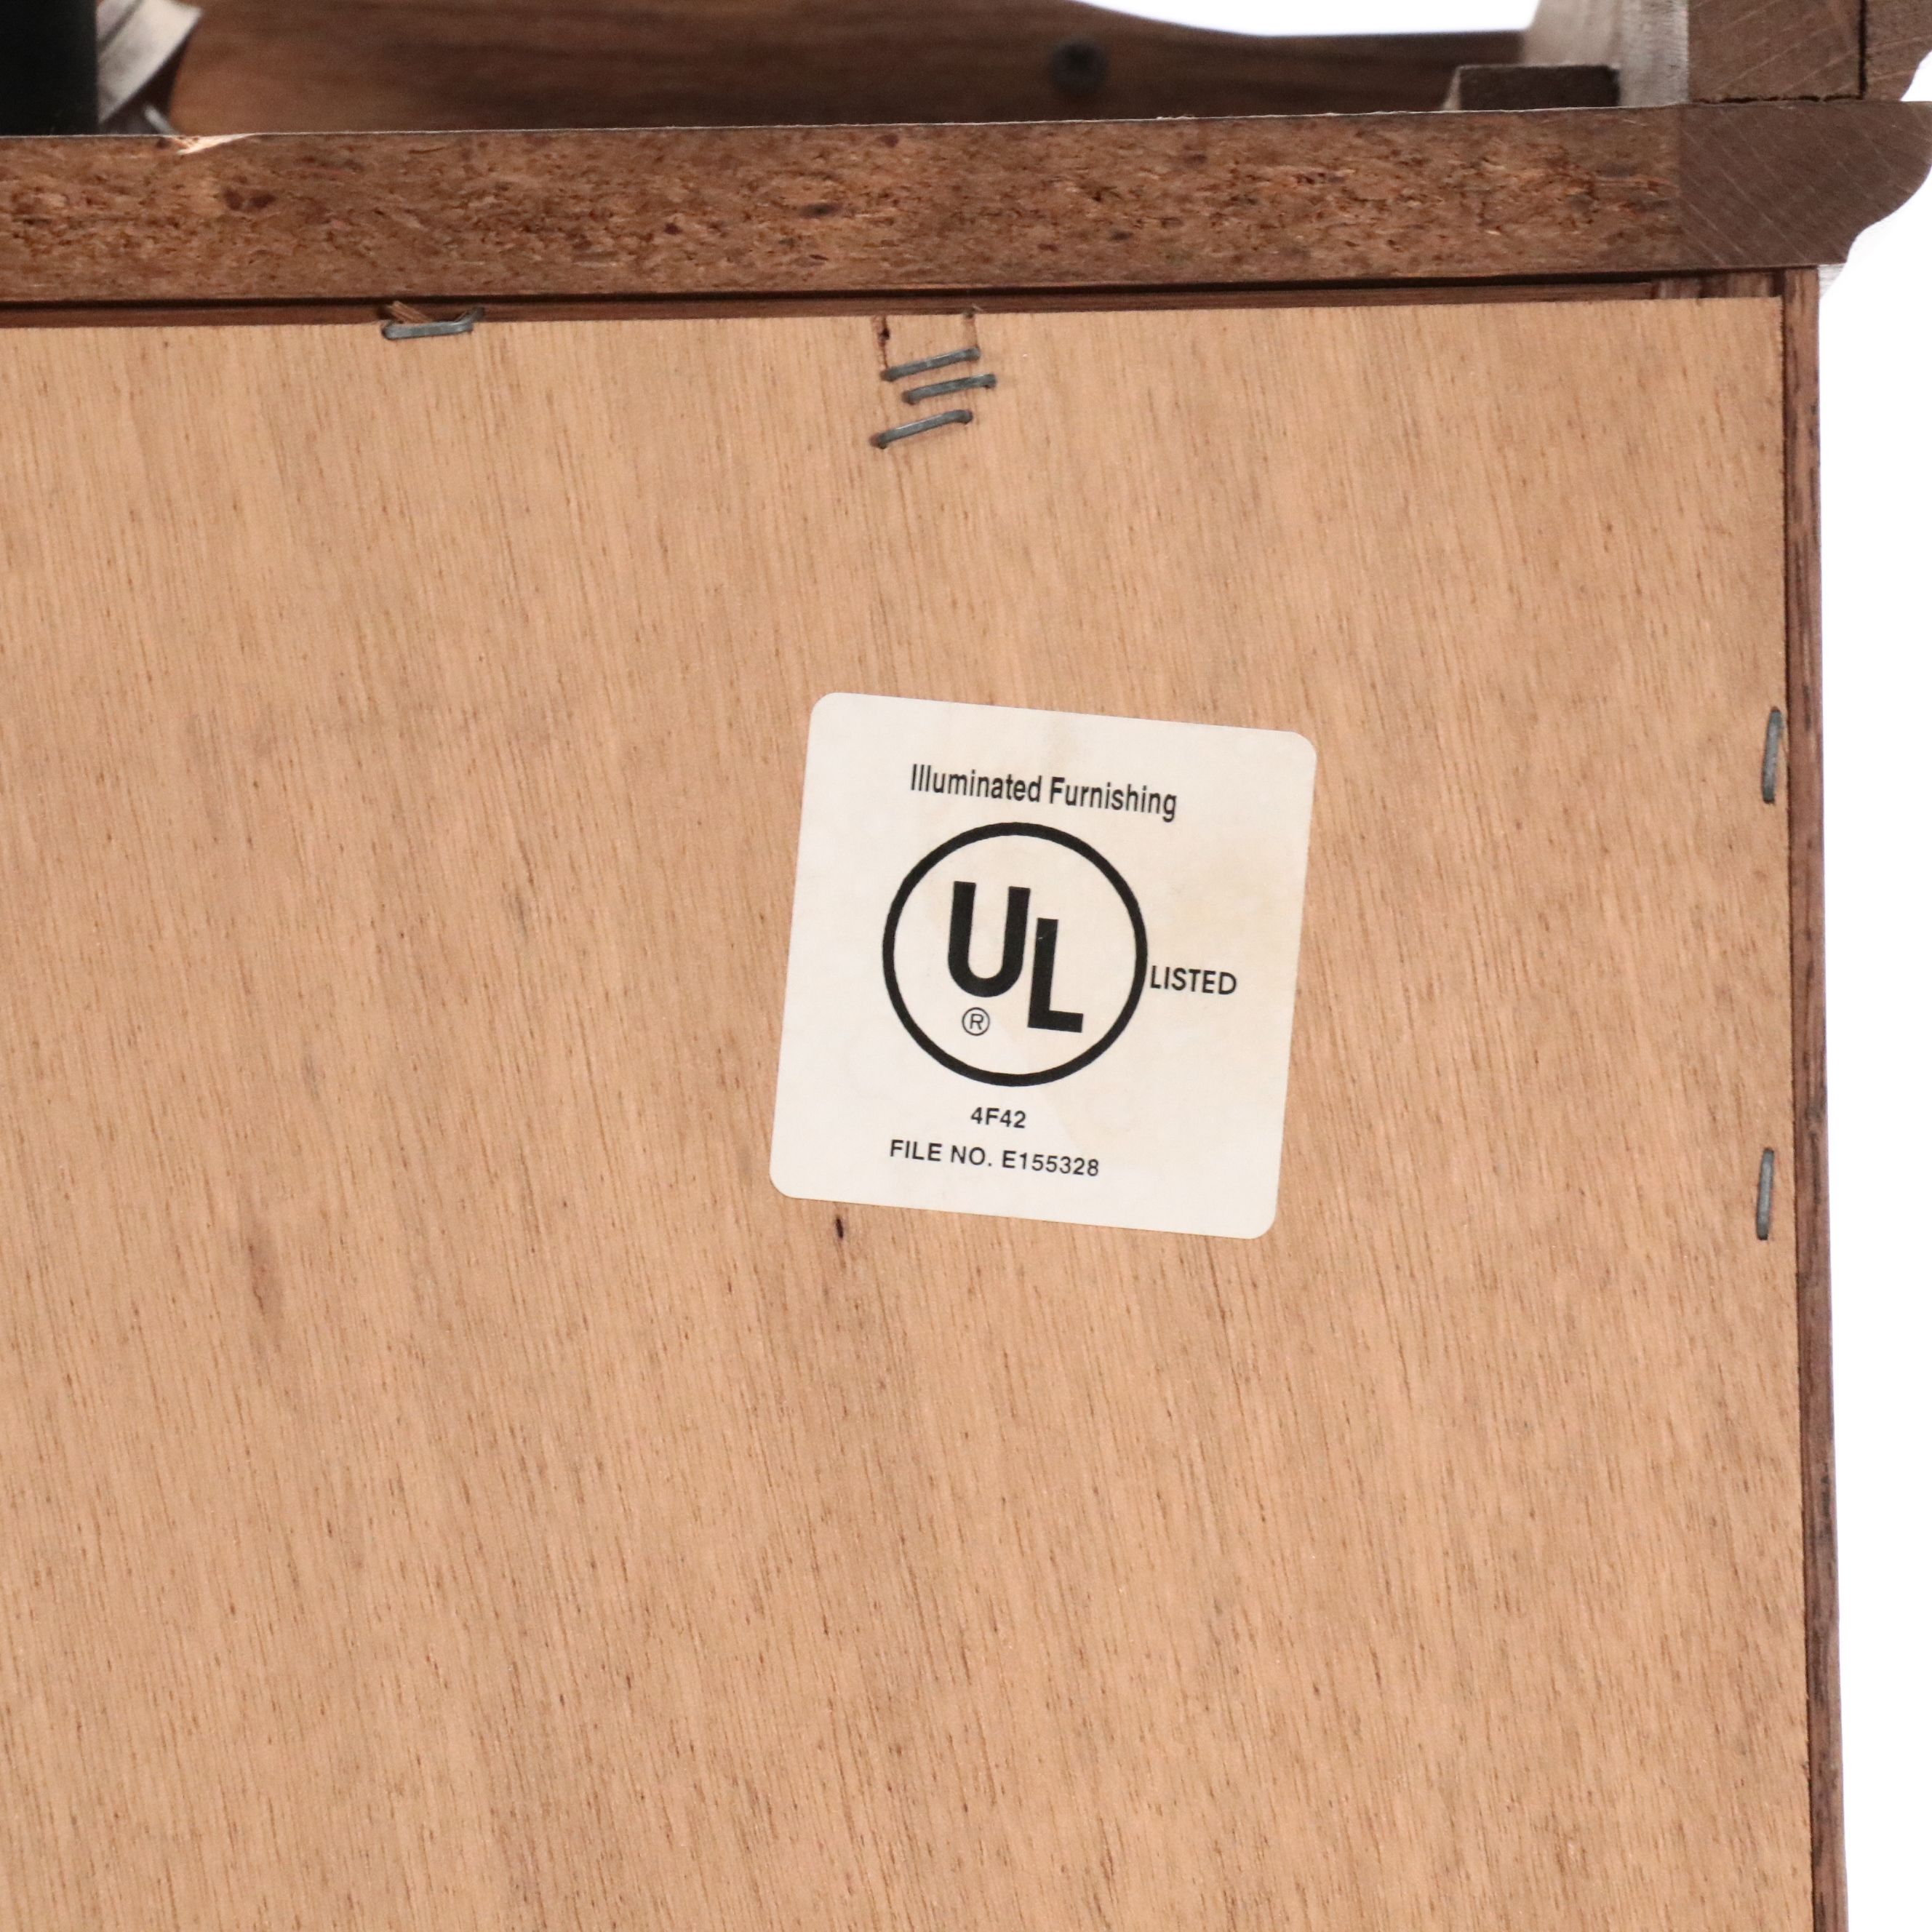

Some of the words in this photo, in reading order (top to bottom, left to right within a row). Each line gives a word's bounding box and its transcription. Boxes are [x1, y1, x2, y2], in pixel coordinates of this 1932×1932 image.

[911, 764, 1042, 803] Illuminated
[1050, 776, 1177, 823] Furnishing
[947, 880, 1084, 1034] UL
[1150, 965, 1237, 995] LISTED
[970, 1106, 1026, 1129] 4F42
[890, 1139, 942, 1162] FILE
[951, 1145, 993, 1167] NO.
[1002, 1150, 1099, 1177] E155328
